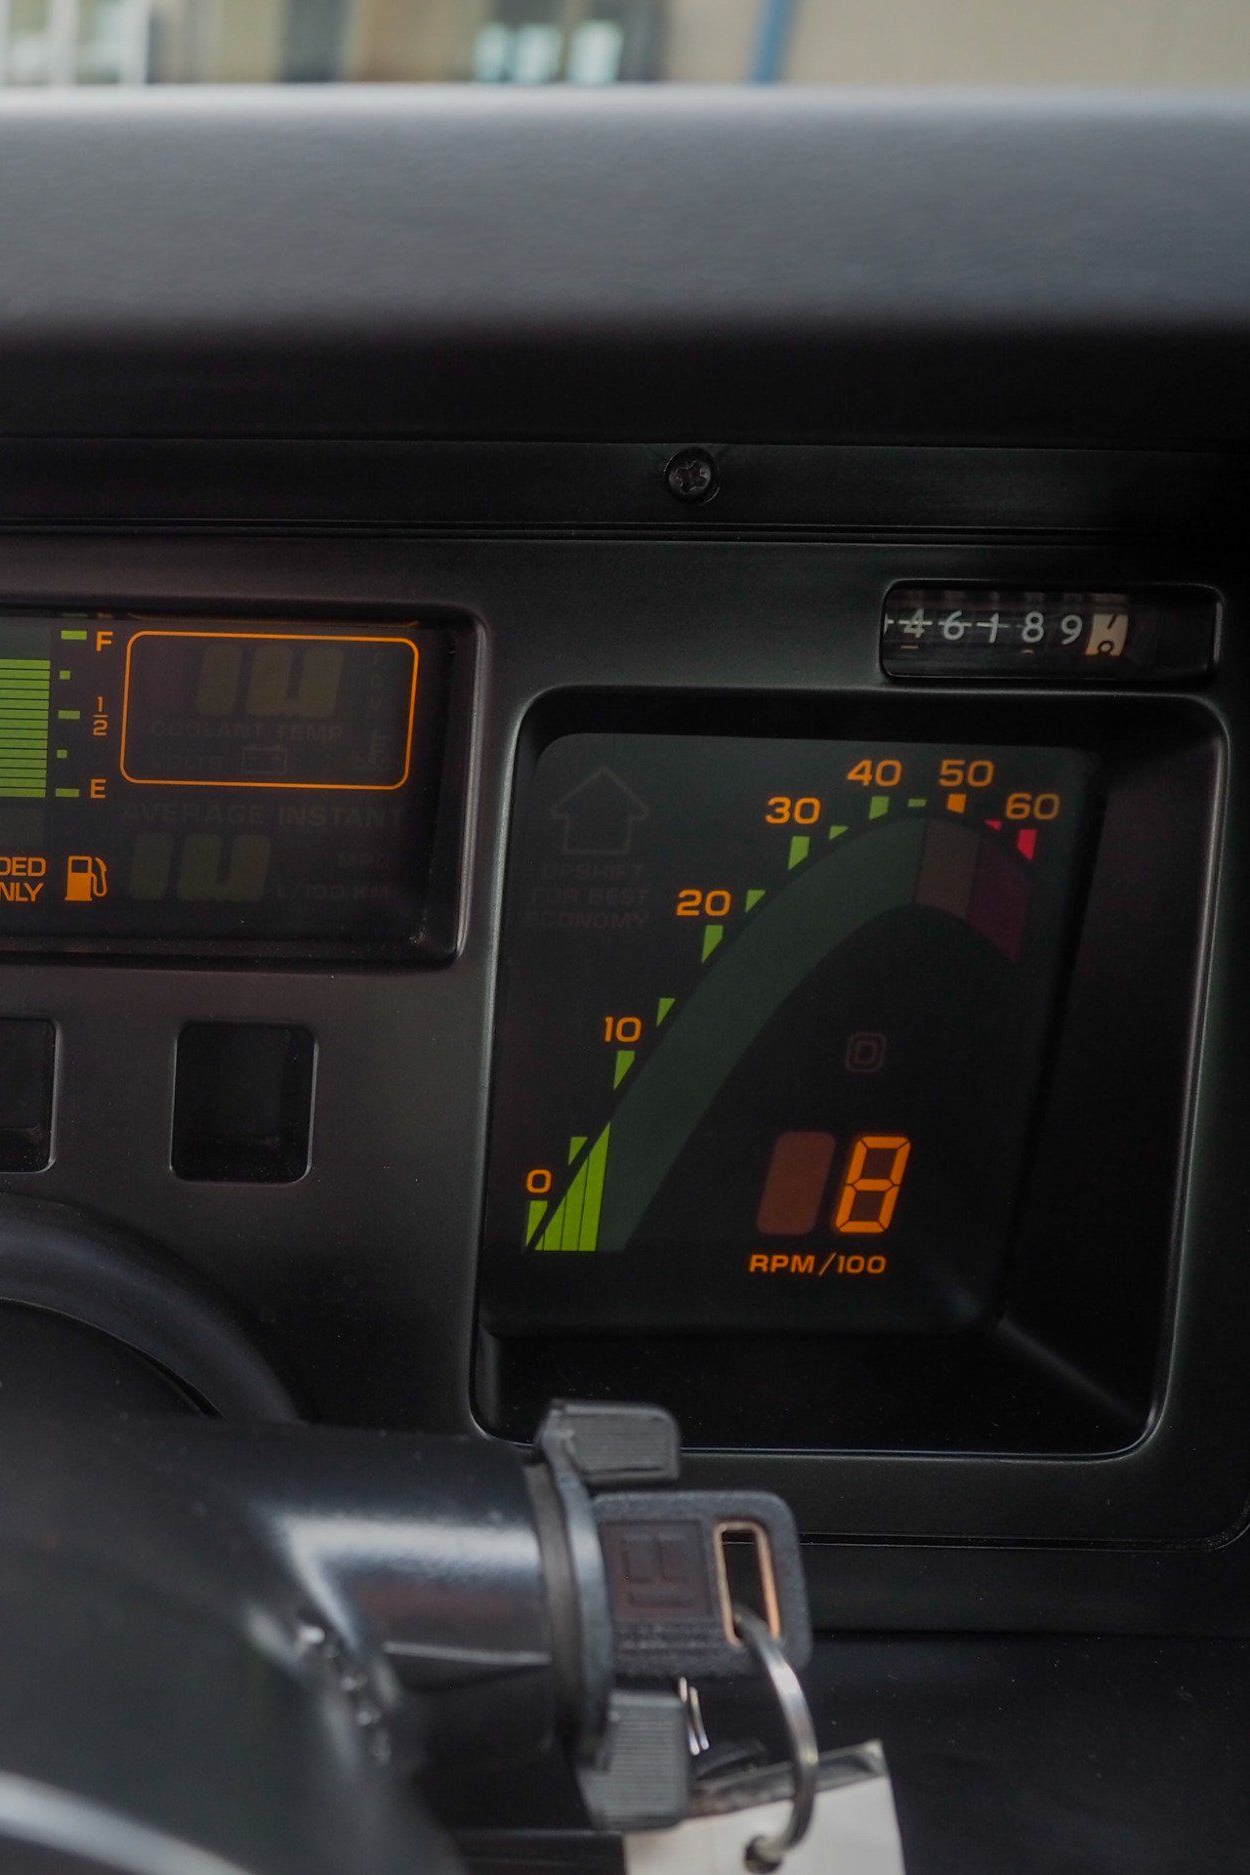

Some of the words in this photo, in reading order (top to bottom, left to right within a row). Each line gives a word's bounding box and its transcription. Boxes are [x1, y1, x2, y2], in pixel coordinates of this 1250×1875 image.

[96, 631, 113, 652] F
[846, 758, 903, 787] 40
[939, 759, 995, 787] 50
[90, 778, 107, 800] E
[765, 795, 822, 825] 30
[1005, 792, 1061, 820] 60
[675, 887, 733, 917] 20
[603, 1015, 643, 1043] 10
[525, 1168, 553, 1195] 0
[832, 1134, 911, 1235] 8
[748, 1252, 888, 1276] RPM/100
